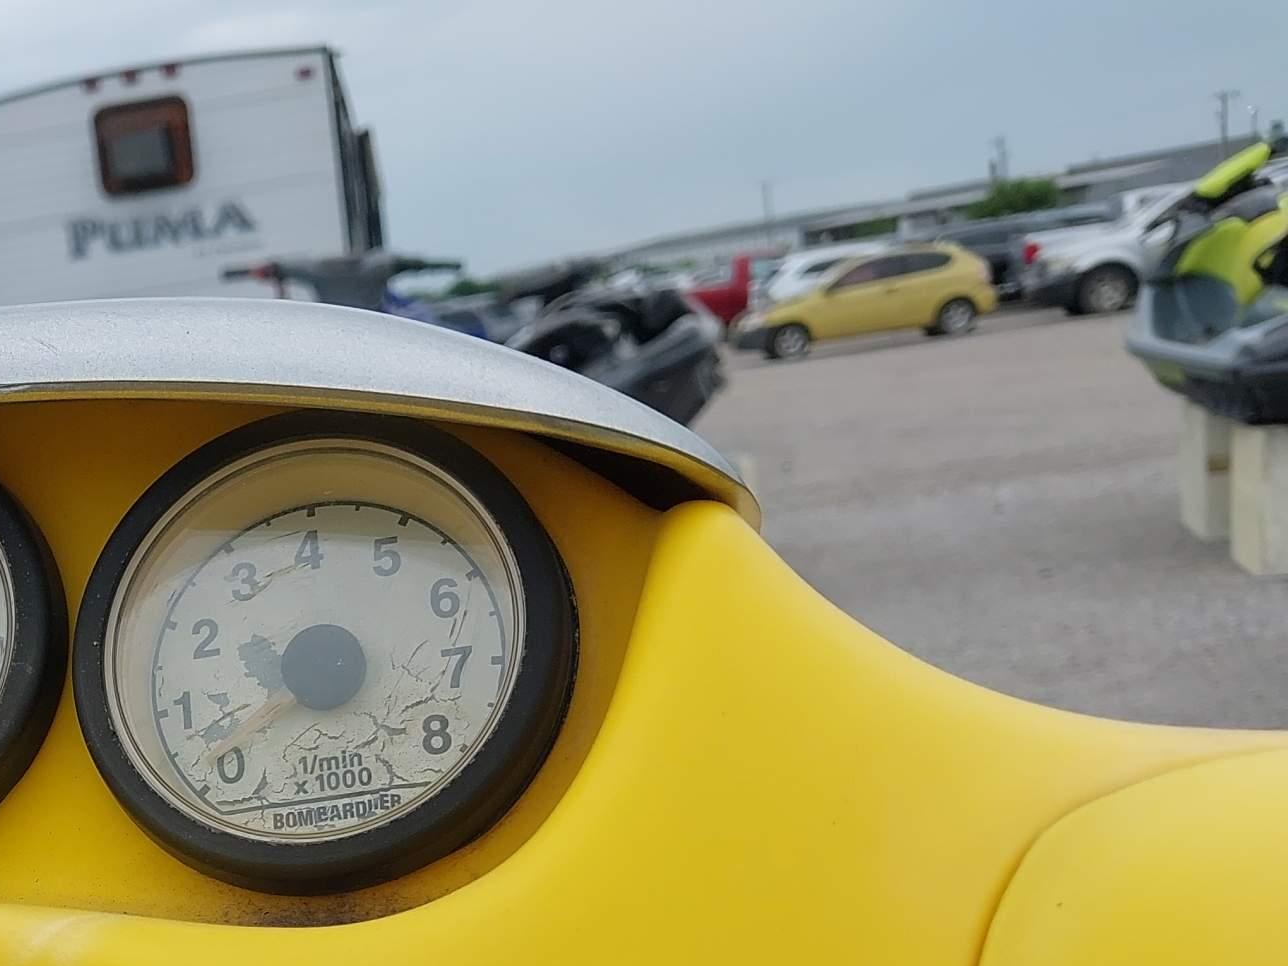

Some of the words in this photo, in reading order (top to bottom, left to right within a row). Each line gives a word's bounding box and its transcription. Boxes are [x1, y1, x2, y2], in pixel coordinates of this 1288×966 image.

[66, 199, 257, 262] PUMA
[294, 530, 324, 570] 4
[372, 536, 401, 577] 5
[231, 562, 258, 602] 3
[430, 578, 461, 618] 6
[191, 618, 220, 660] 2
[440, 645, 473, 689] 7
[173, 690, 193, 729] 1
[422, 714, 453, 755] 8
[216, 746, 245, 784] 0
[298, 751, 363, 776] 1/min
